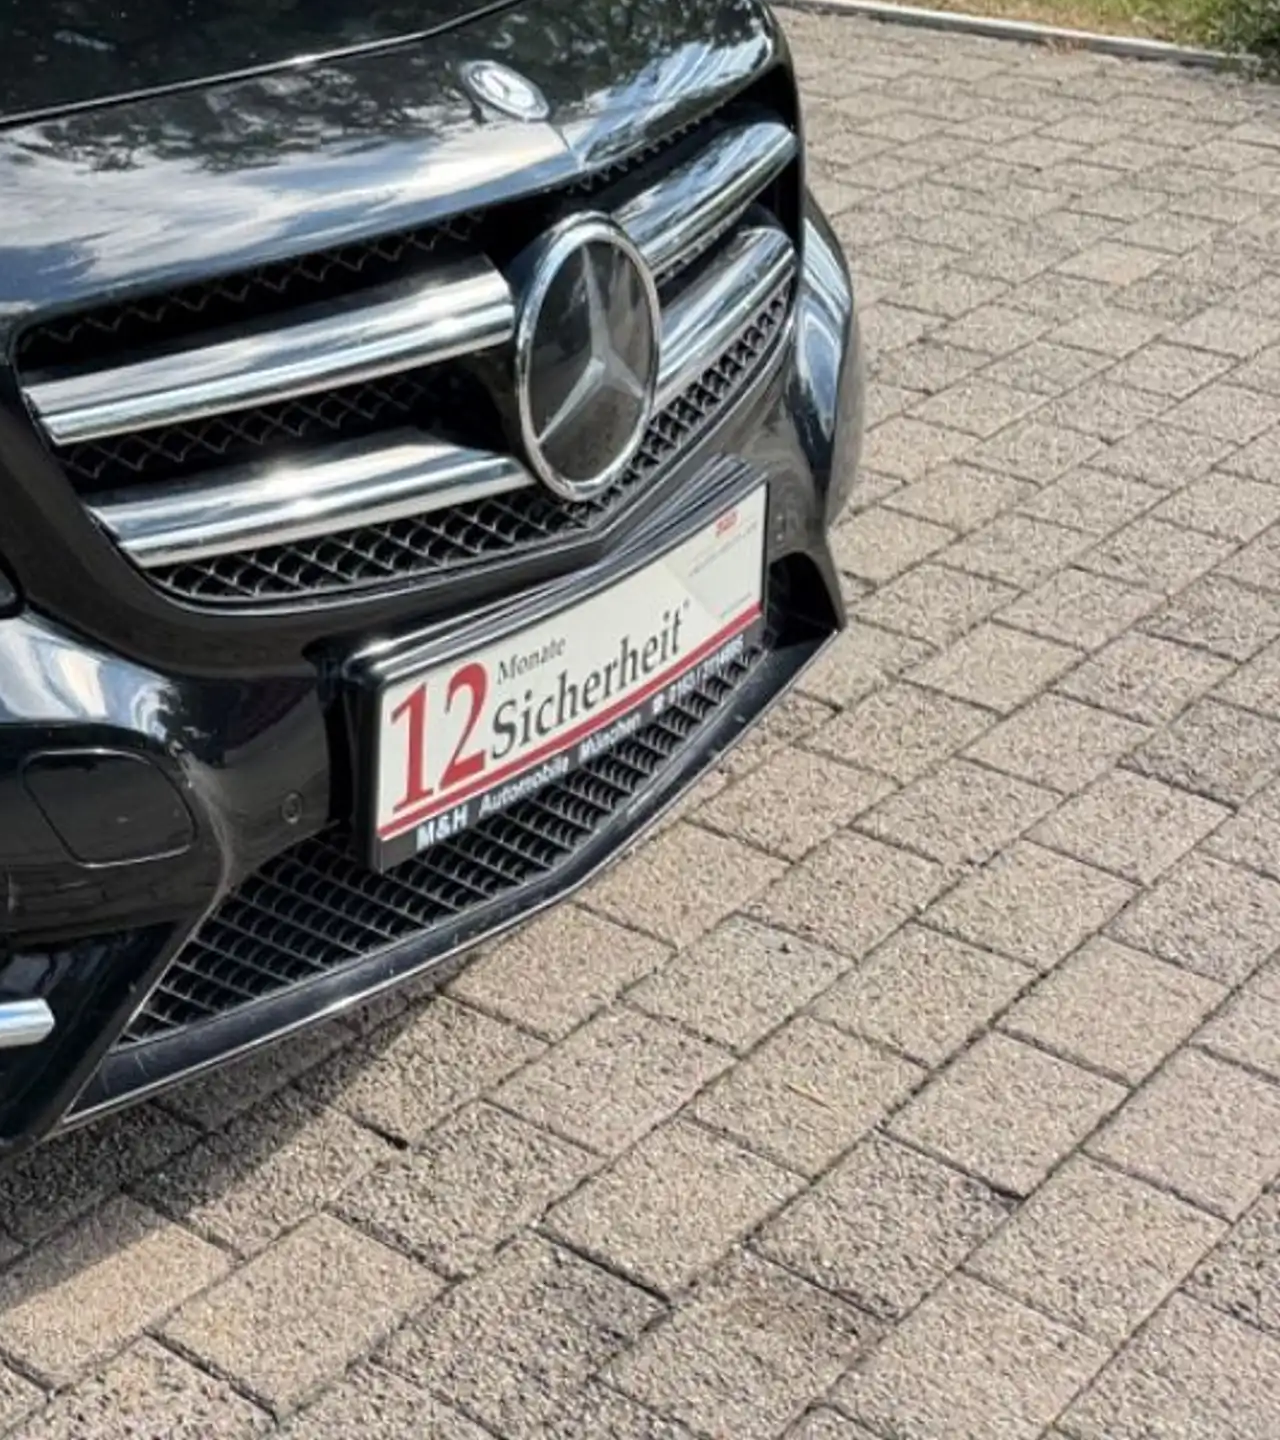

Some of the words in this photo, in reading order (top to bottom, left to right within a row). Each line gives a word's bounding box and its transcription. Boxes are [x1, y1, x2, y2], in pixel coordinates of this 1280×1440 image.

[491, 606, 684, 761] Sicherheit
[496, 635, 567, 686] Monate
[391, 661, 489, 816] 12
